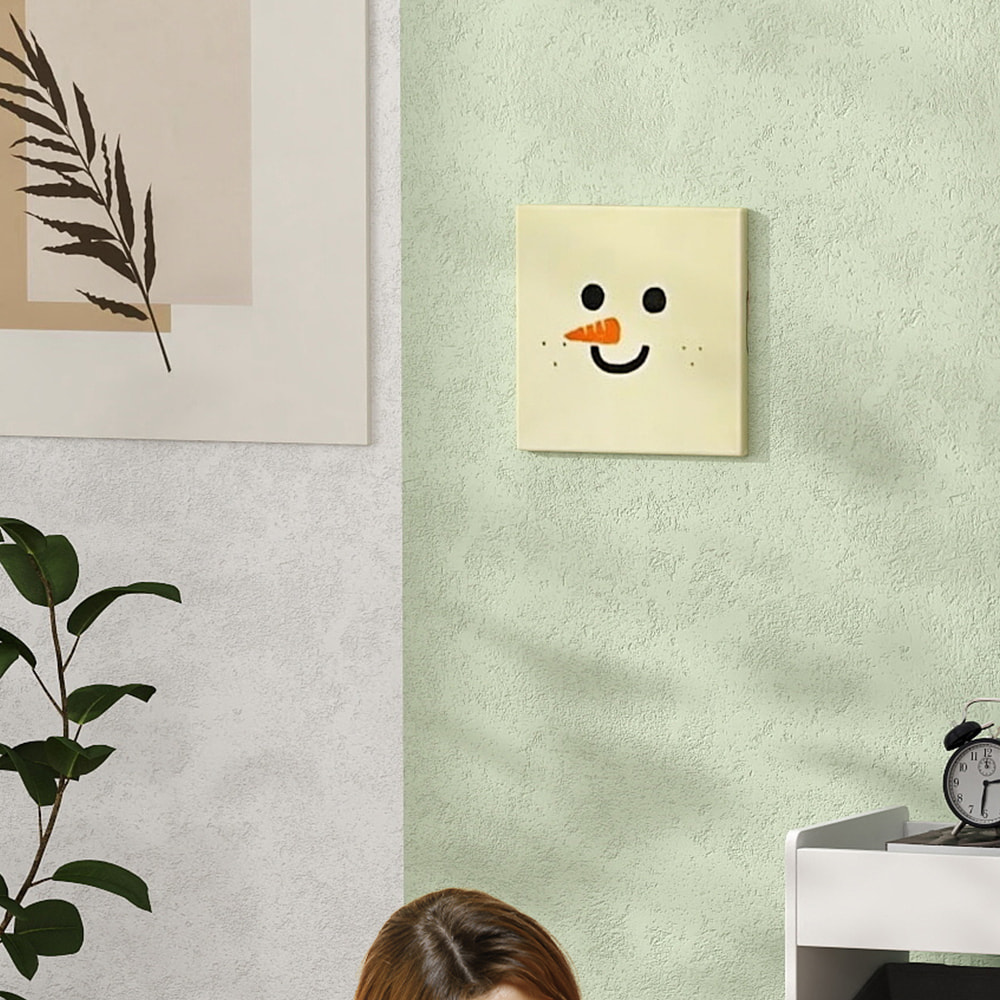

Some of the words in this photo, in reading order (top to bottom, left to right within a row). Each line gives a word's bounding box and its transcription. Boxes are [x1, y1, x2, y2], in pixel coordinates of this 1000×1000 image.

[971, 751, 978, 761] 11
[983, 748, 993, 758] 12
[960, 762, 968, 773] 10
[953, 777, 960, 788] 9
[957, 793, 964, 803] 8
[968, 804, 975, 814] 7
[982, 808, 989, 819] 6
